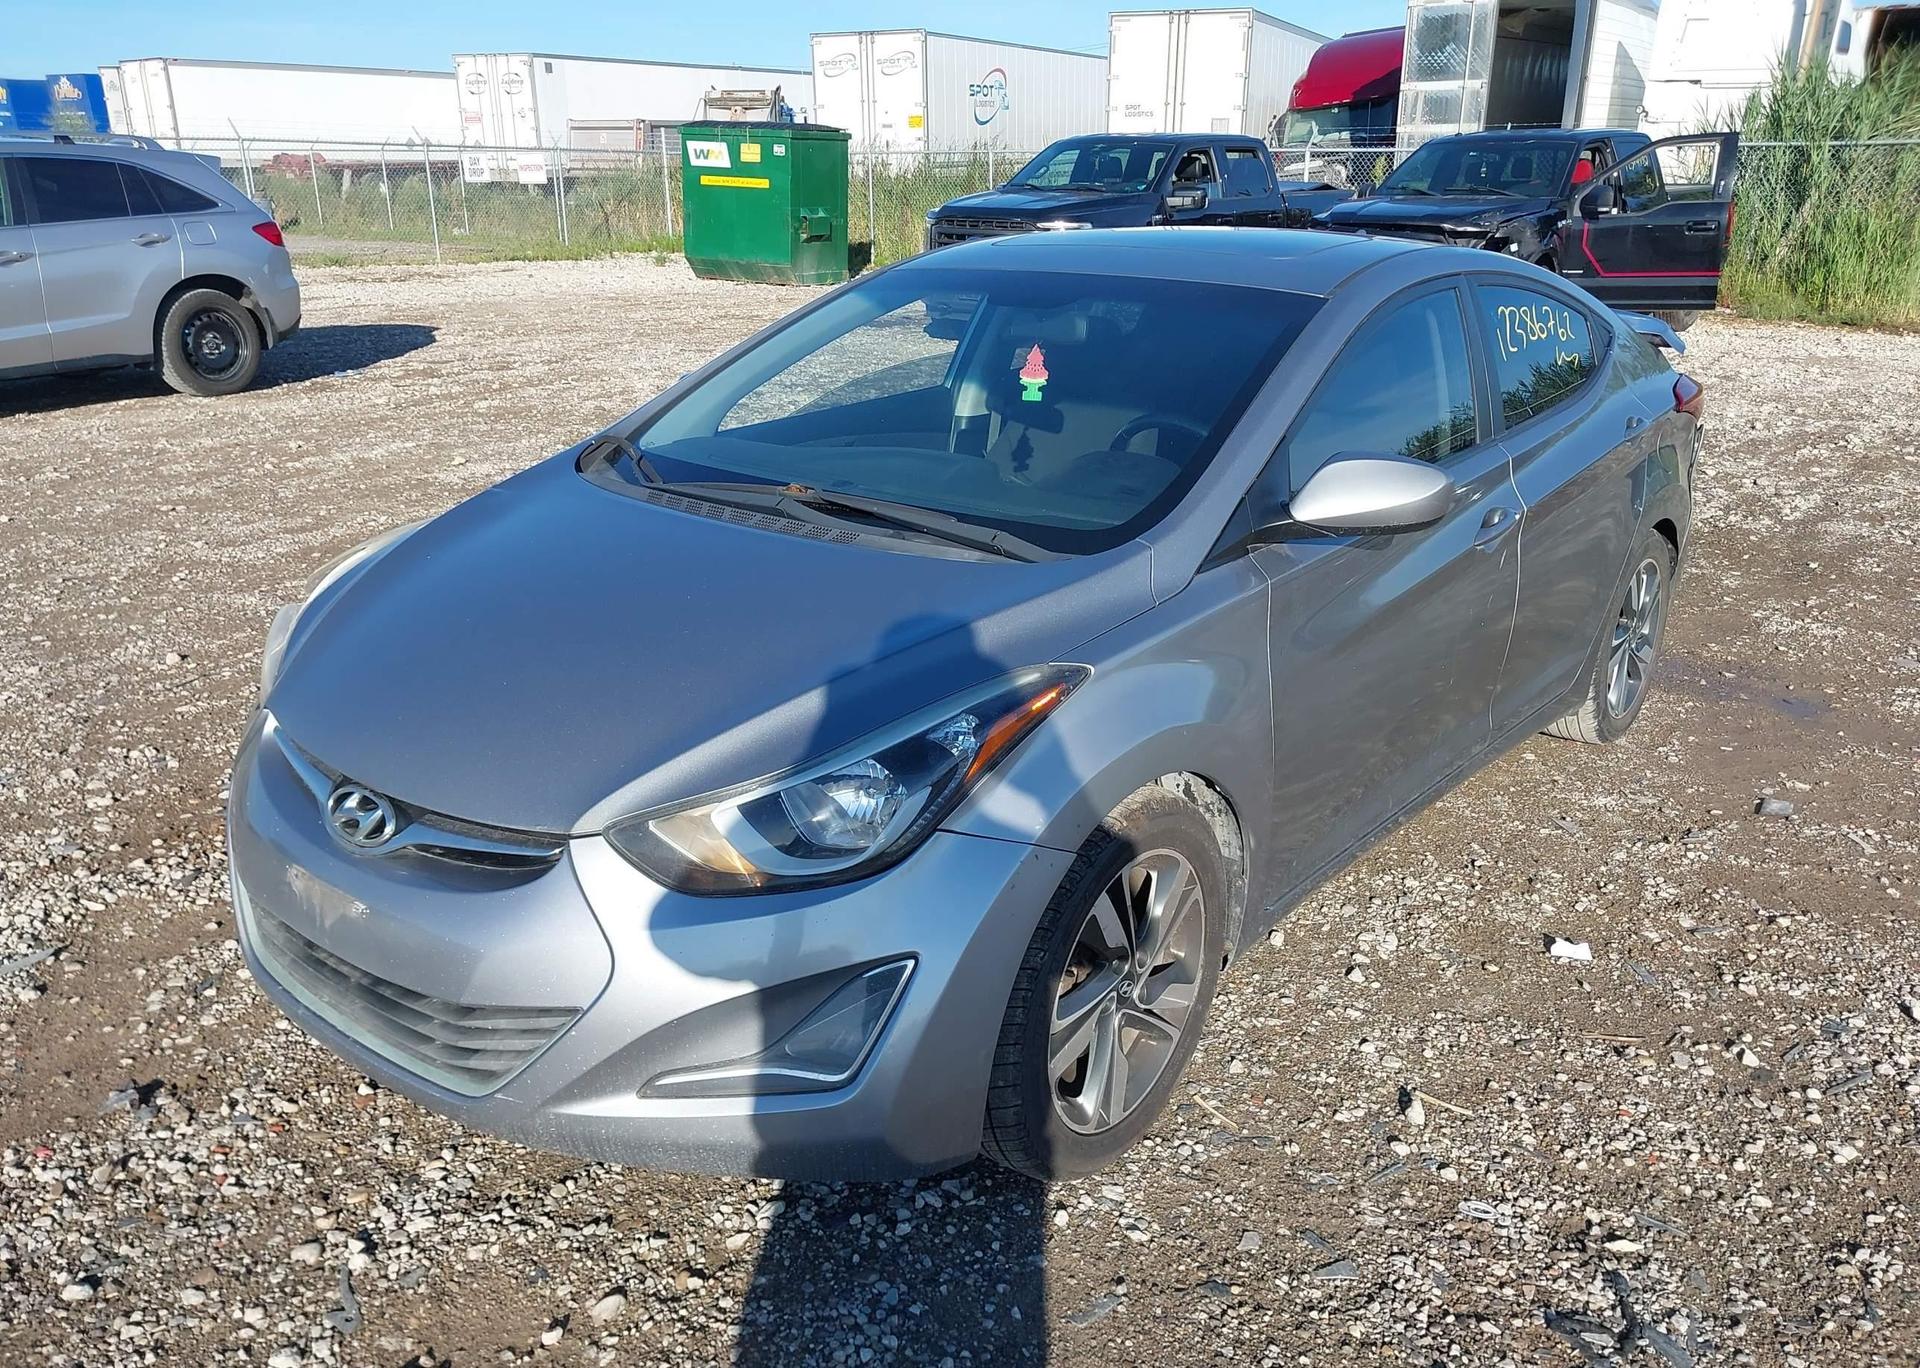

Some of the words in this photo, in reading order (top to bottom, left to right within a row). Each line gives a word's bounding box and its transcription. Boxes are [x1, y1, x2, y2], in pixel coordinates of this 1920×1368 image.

[969, 84, 994, 97] SPOT
[976, 100, 995, 108] LOGISTICS
[693, 148, 724, 160] WM
[468, 156, 481, 166] DAY
[468, 167, 485, 178] DROP
[518, 164, 544, 172] INSPECTION
[1496, 302, 1576, 362] 12386762
